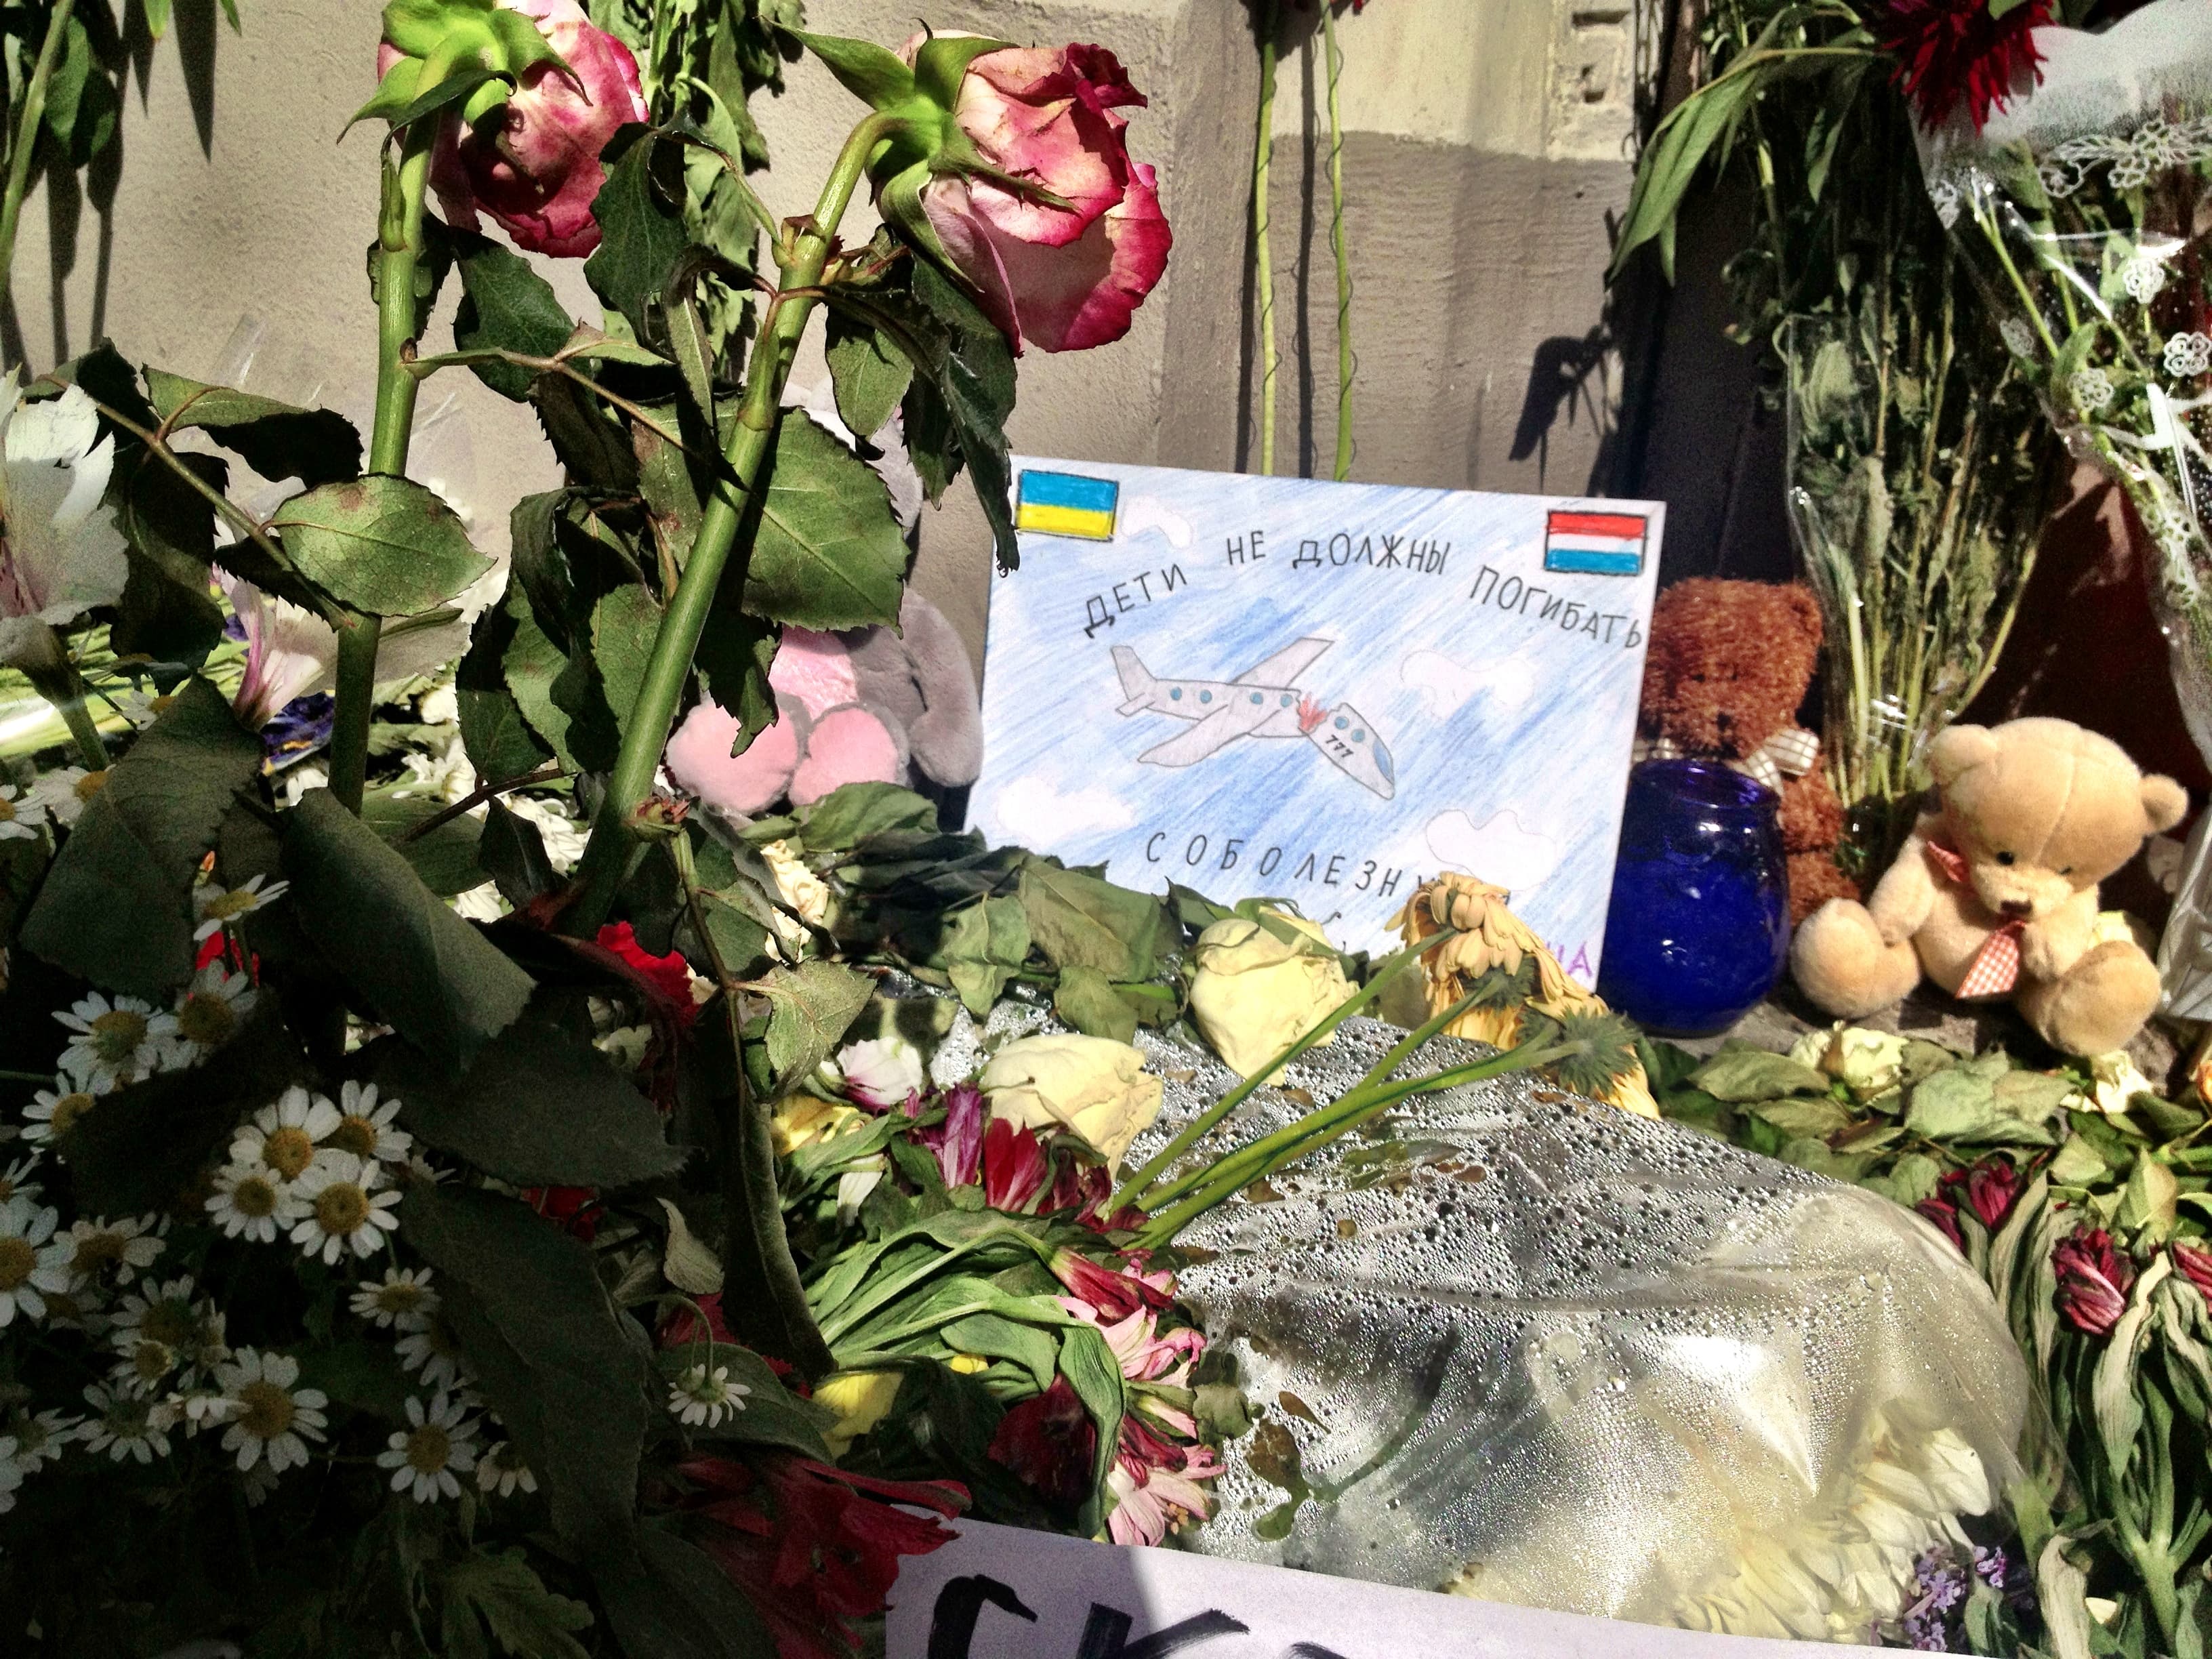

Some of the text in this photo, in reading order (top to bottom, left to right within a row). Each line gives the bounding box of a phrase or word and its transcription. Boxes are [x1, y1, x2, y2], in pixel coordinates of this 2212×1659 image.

[1084, 530, 1643, 648] ДЕТИ НЕ ДОЛЖНЫ ПОГИБАТЬ
